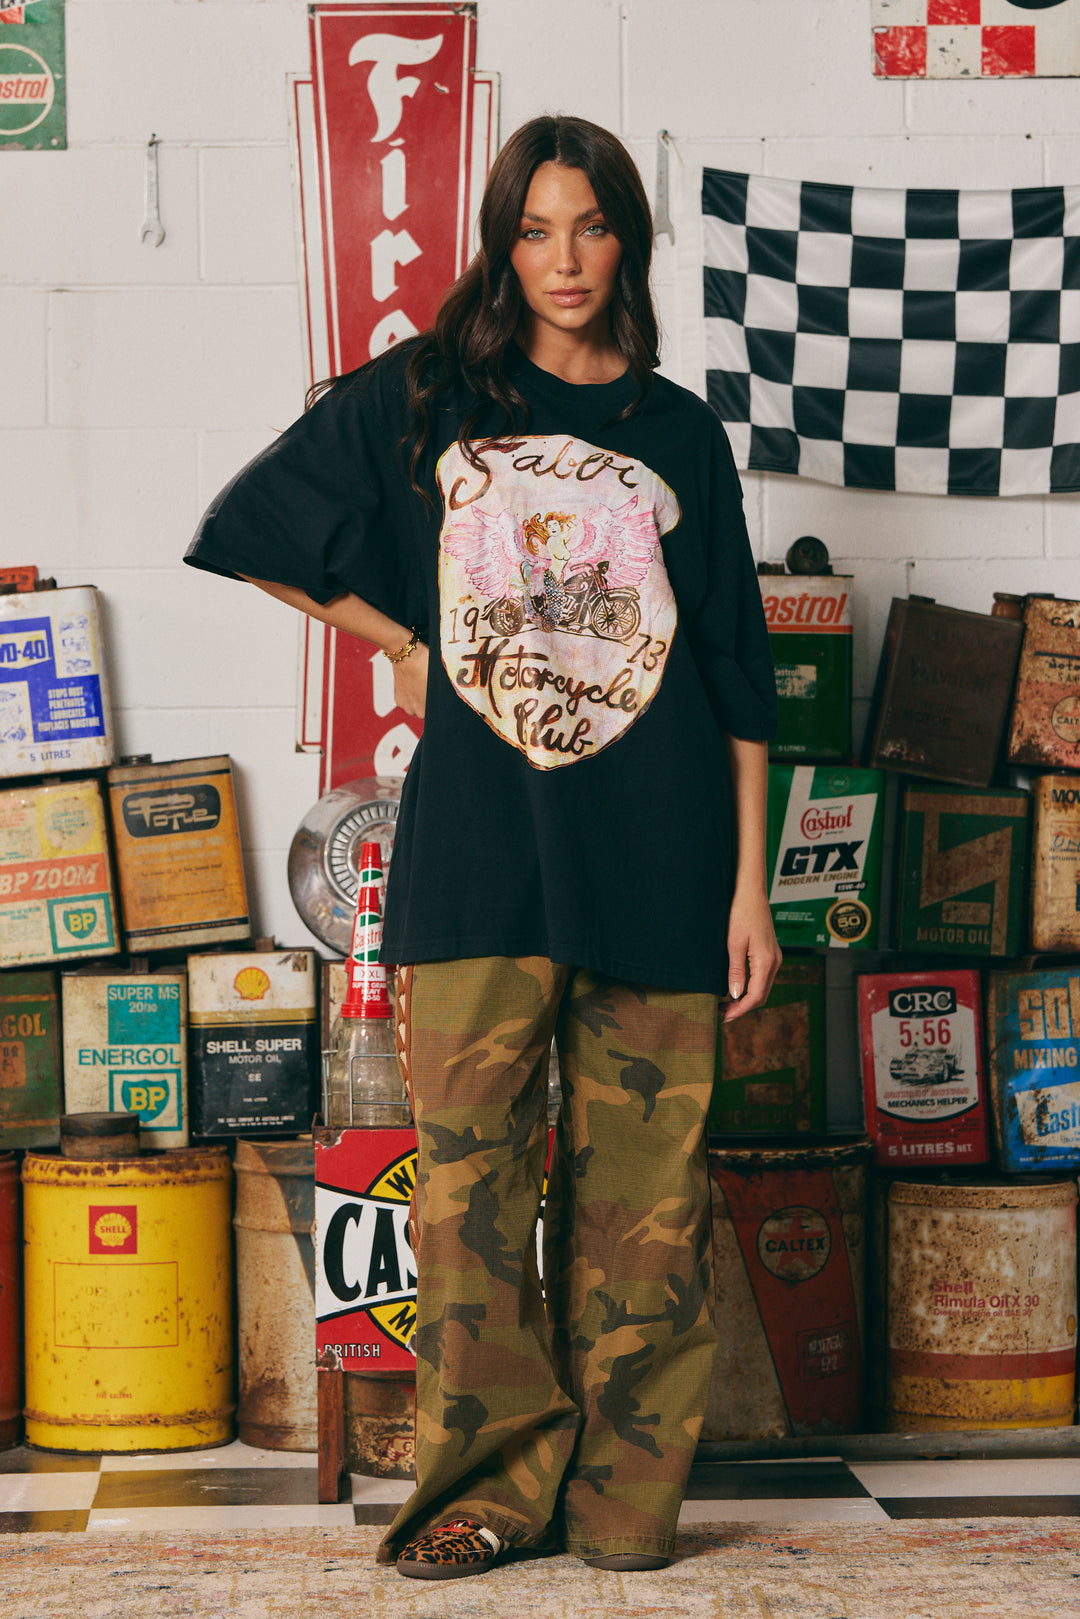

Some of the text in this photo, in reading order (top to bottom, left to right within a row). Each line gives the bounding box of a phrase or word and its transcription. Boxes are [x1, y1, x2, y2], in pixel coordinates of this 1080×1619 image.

[762, 593, 847, 624] astrol
[448, 606, 480, 643] 19
[1051, 617, 1080, 629] CA
[626, 633, 667, 671] 73
[456, 636, 638, 719] Motorcycle
[49, 697, 85, 710] PENETRATES
[513, 698, 593, 755] Club
[30, 750, 72, 762] 5 LITRES
[800, 805, 853, 840] Castrol
[780, 840, 865, 877] GTX
[0, 862, 99, 895] BP ZOOM
[778, 871, 860, 887] MODERN ENGINE
[69, 913, 95, 932] BP
[837, 915, 862, 928] 50
[917, 927, 991, 945] MOTOR OIL
[108, 986, 179, 1001] SUPER MS
[893, 991, 952, 1013] CRC
[0, 1013, 47, 1038] GOL
[206, 1038, 302, 1054] SHELL SUPER
[78, 1048, 182, 1066] ENERGOL
[229, 1053, 281, 1065] MOTOR OIL
[1014, 1047, 1078, 1069] MIXING
[248, 1073, 262, 1082] SE
[128, 1086, 166, 1111] BP
[887, 1097, 968, 1109] MECHANICS HELPER
[888, 1145, 898, 1157] 5
[902, 1142, 954, 1156] LITRES
[100, 1225, 127, 1234] SHELL
[765, 1238, 825, 1253] CALTEX
[933, 1280, 974, 1294] Shell
[934, 1295, 1040, 1308] Rimula Oil X 30
[323, 1343, 381, 1357] BRITISH
